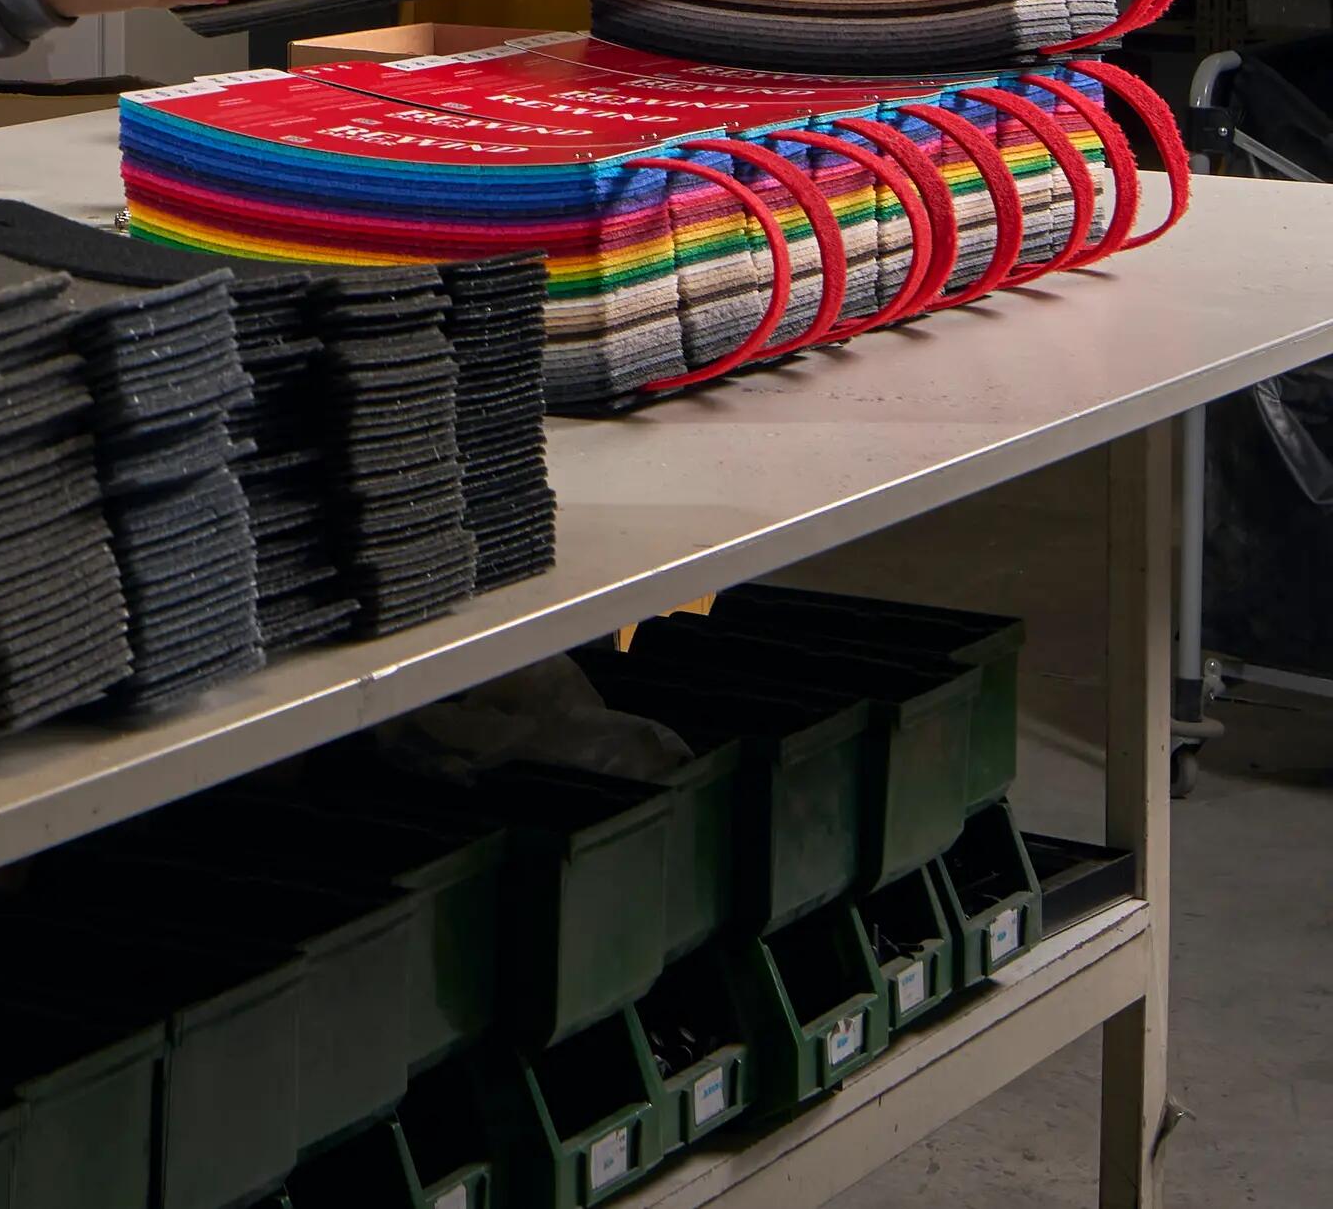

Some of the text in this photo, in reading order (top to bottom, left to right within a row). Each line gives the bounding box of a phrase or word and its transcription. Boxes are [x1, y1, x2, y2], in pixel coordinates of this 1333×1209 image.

[485, 94, 679, 122] REWIND
[557, 90, 750, 110] REWIND
[396, 109, 594, 136] REWIND
[326, 125, 530, 153] REWIND
